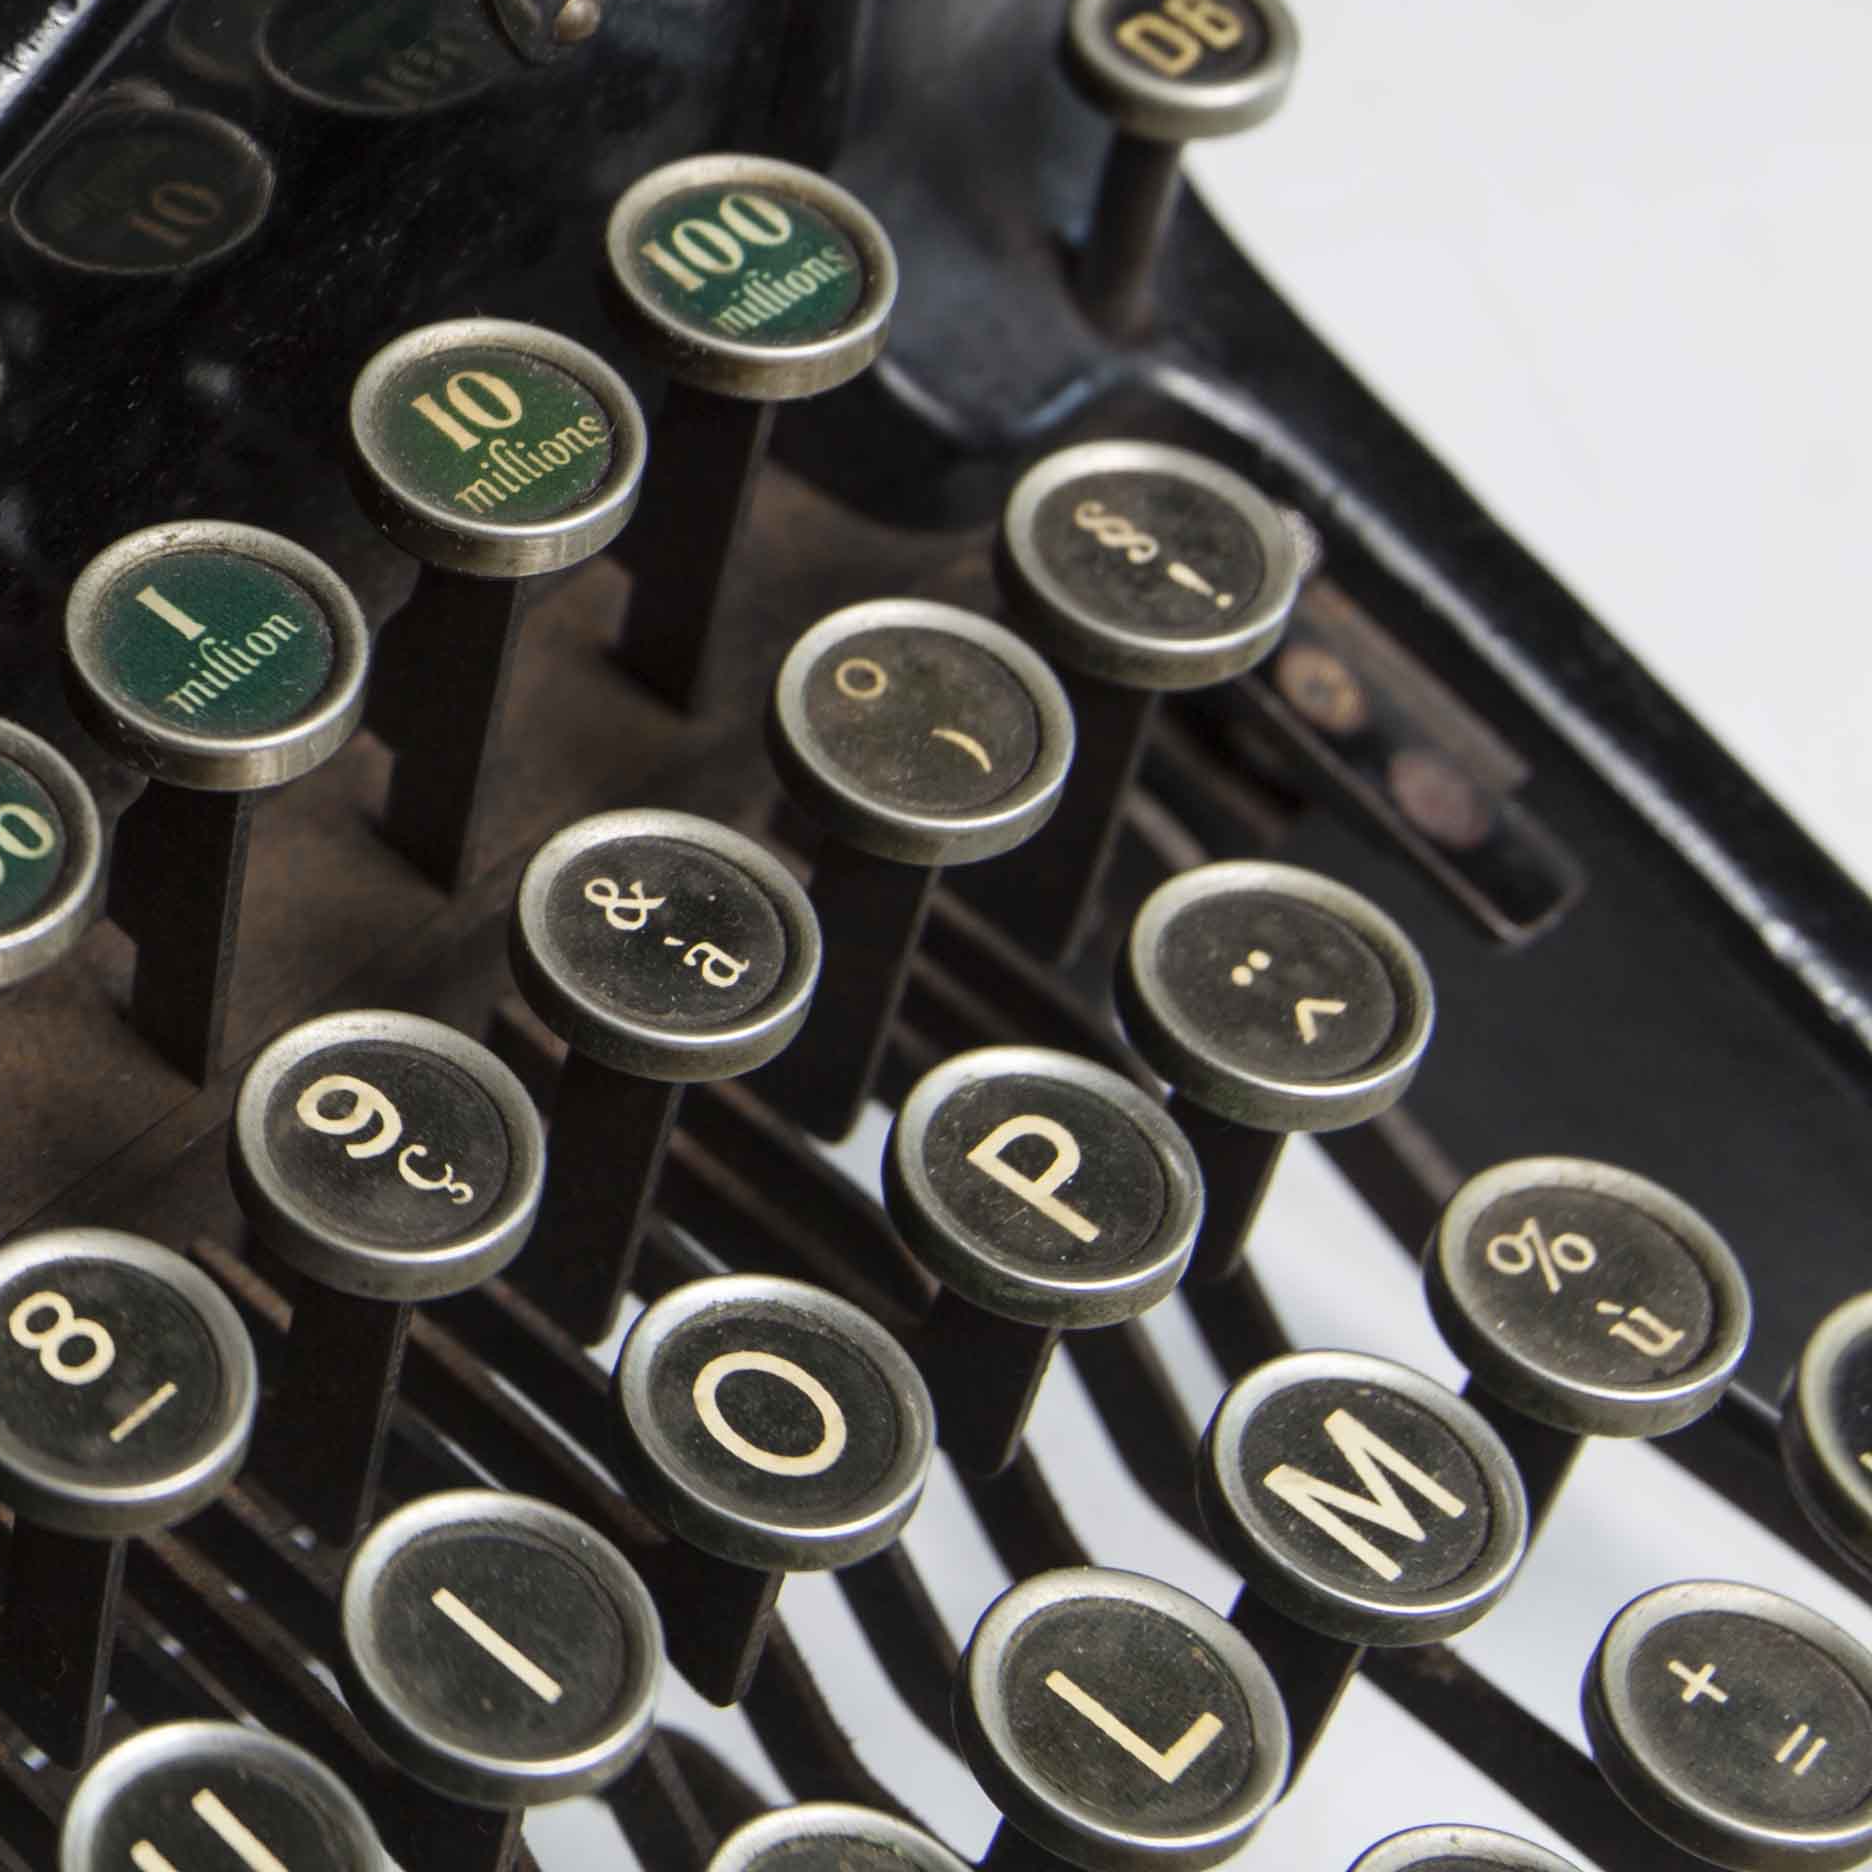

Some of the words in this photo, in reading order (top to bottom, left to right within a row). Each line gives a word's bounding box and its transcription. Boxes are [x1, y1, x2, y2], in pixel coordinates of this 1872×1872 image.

[643, 196, 791, 290] 100
[714, 242, 849, 336] millions
[413, 372, 522, 451] 10
[455, 416, 606, 513] millions
[137, 586, 205, 640] 1
[167, 615, 300, 714] million
[585, 878, 665, 930] &
[298, 1075, 402, 1158] 9
[965, 1112, 1101, 1243] P
[1487, 1218, 1596, 1292] %
[9, 1291, 115, 1384] 8
[693, 1351, 846, 1476] O
[1262, 1407, 1467, 1581] M
[432, 1589, 562, 1703] I
[1044, 1669, 1224, 1784] L
